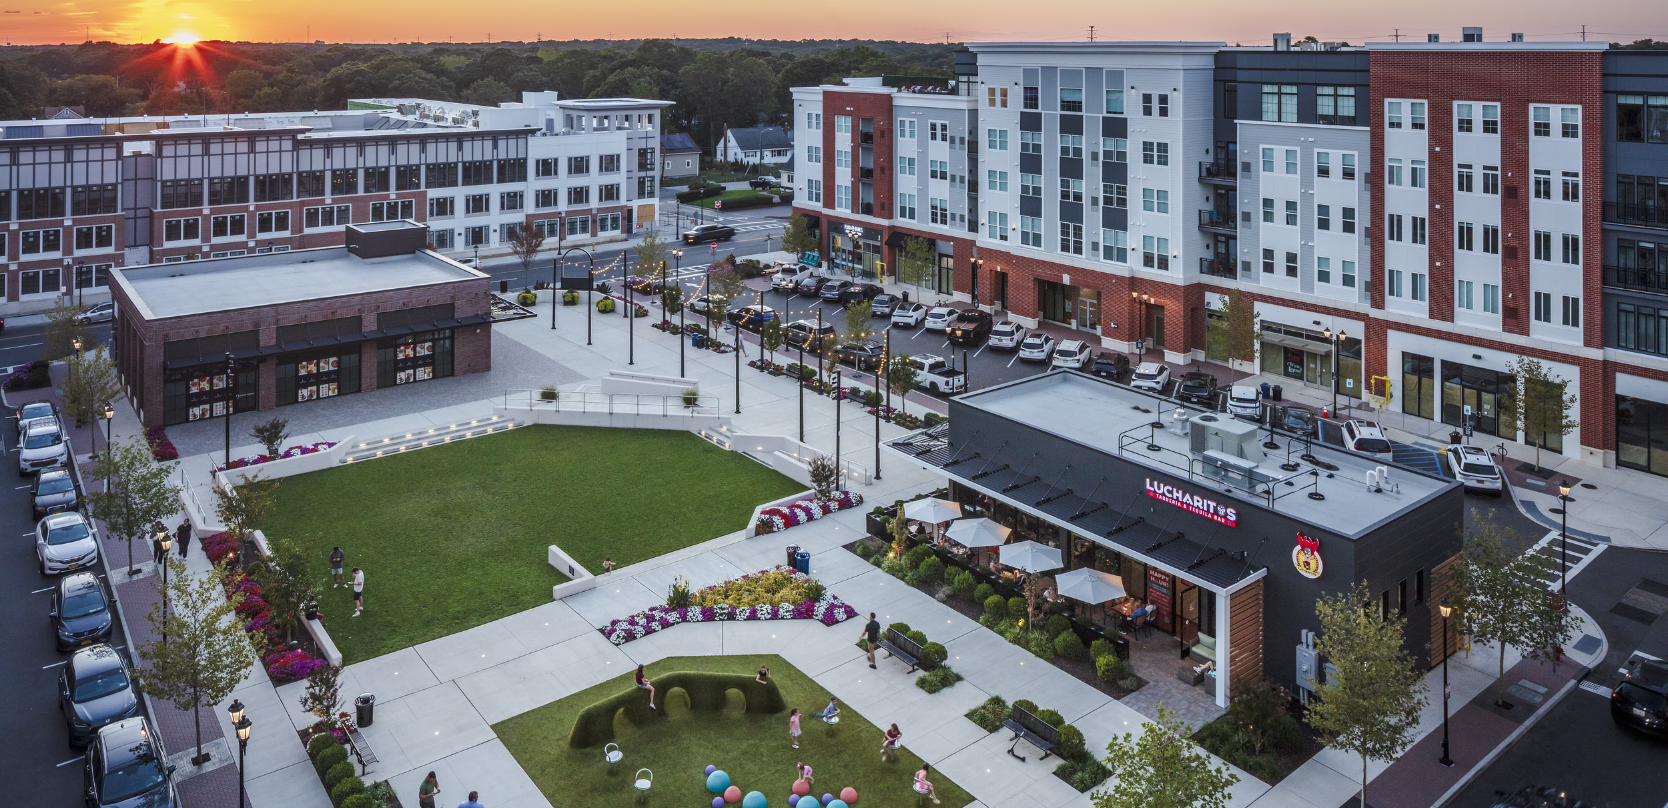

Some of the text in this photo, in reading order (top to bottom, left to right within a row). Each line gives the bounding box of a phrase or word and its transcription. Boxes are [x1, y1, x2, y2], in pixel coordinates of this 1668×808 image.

[1146, 478, 1237, 521] LUCHARITOS
[1156, 493, 1181, 507] TAQUERIA
[1189, 505, 1212, 519] TEQUILA
[1214, 514, 1225, 524] BAR
[1149, 570, 1170, 582] HAPPY
